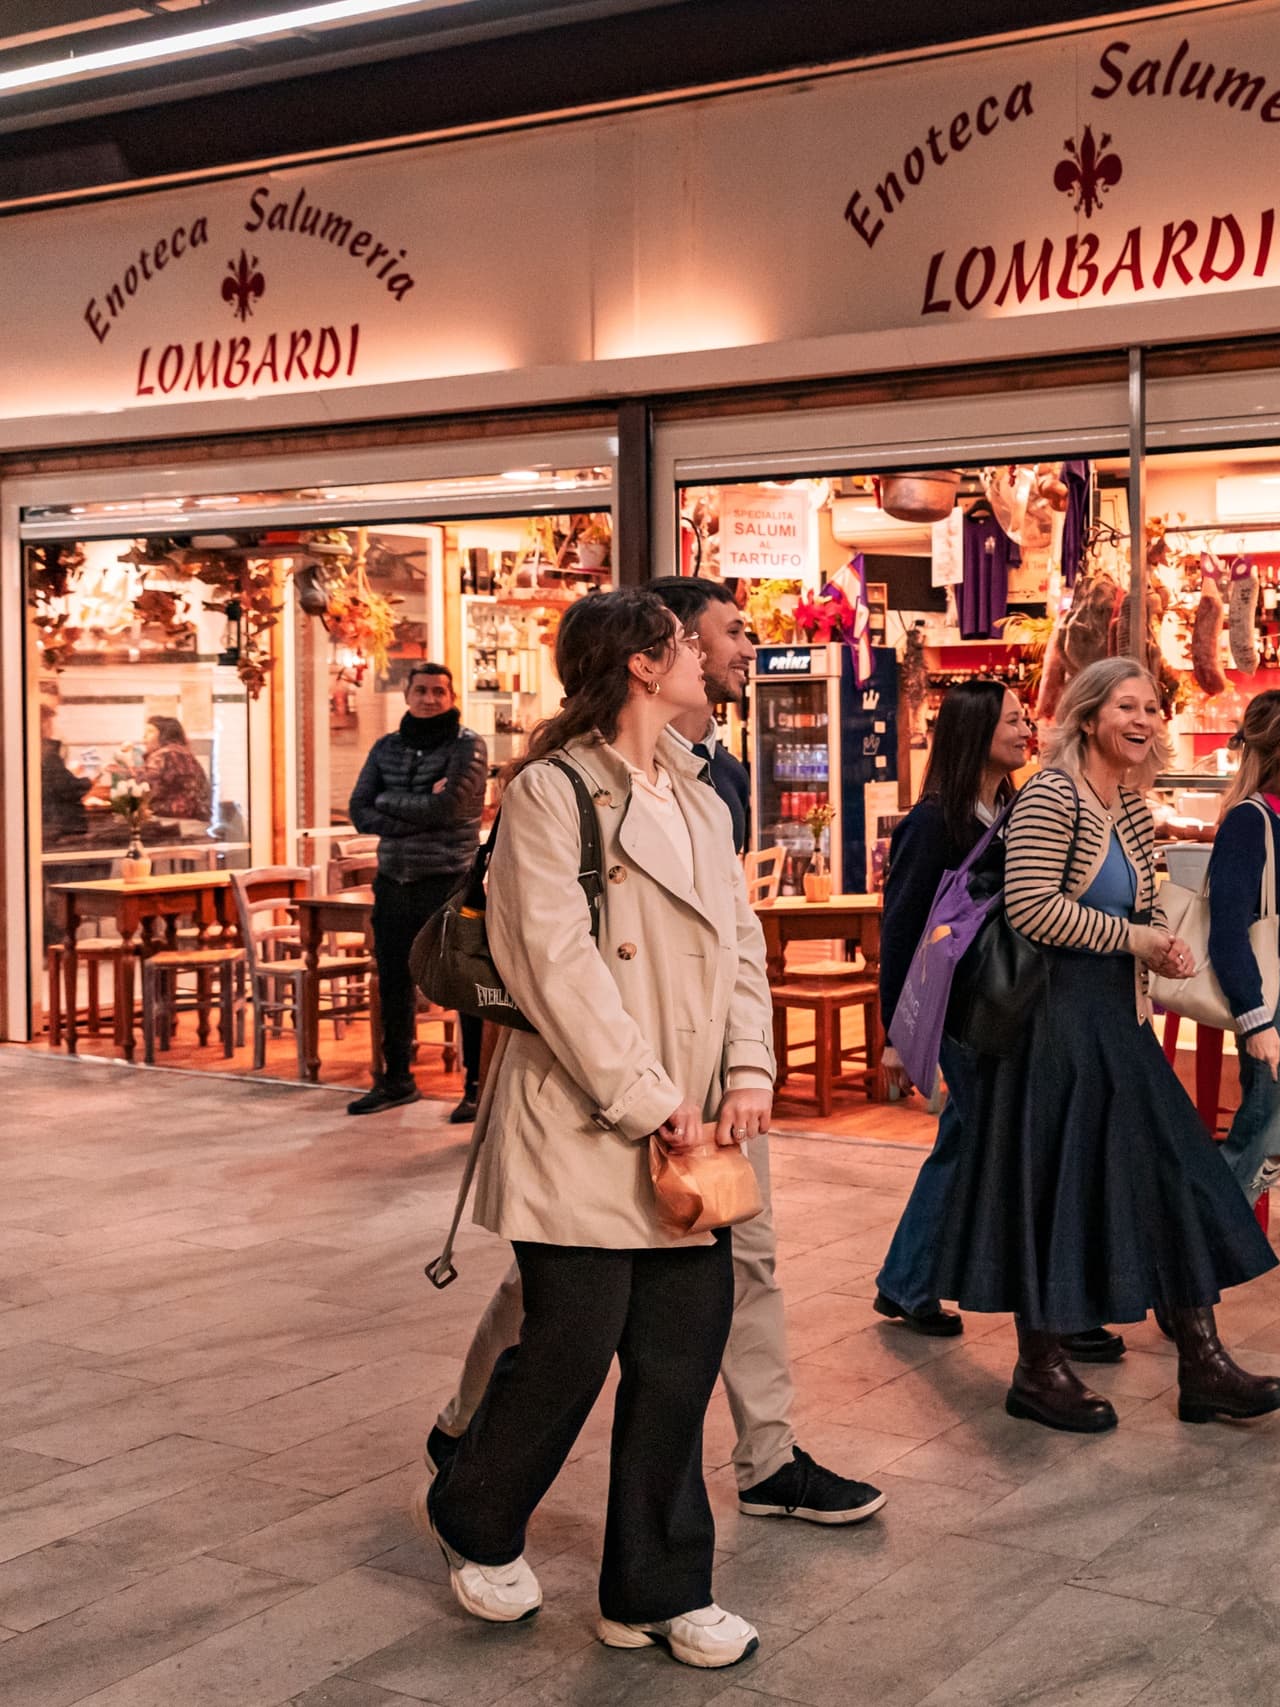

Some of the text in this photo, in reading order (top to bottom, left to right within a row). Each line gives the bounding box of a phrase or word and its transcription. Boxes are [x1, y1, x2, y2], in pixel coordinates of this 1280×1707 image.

[844, 80, 1034, 249] Enoteca
[84, 186, 416, 345] Enoteca Salumeria
[920, 207, 1275, 316] LOMBARDI
[136, 322, 360, 396] LOMBARDI
[734, 521, 797, 538] SALUMI
[759, 540, 772, 550] AL
[729, 550, 802, 568] TARTUFO
[475, 983, 518, 1011] EVERLA
